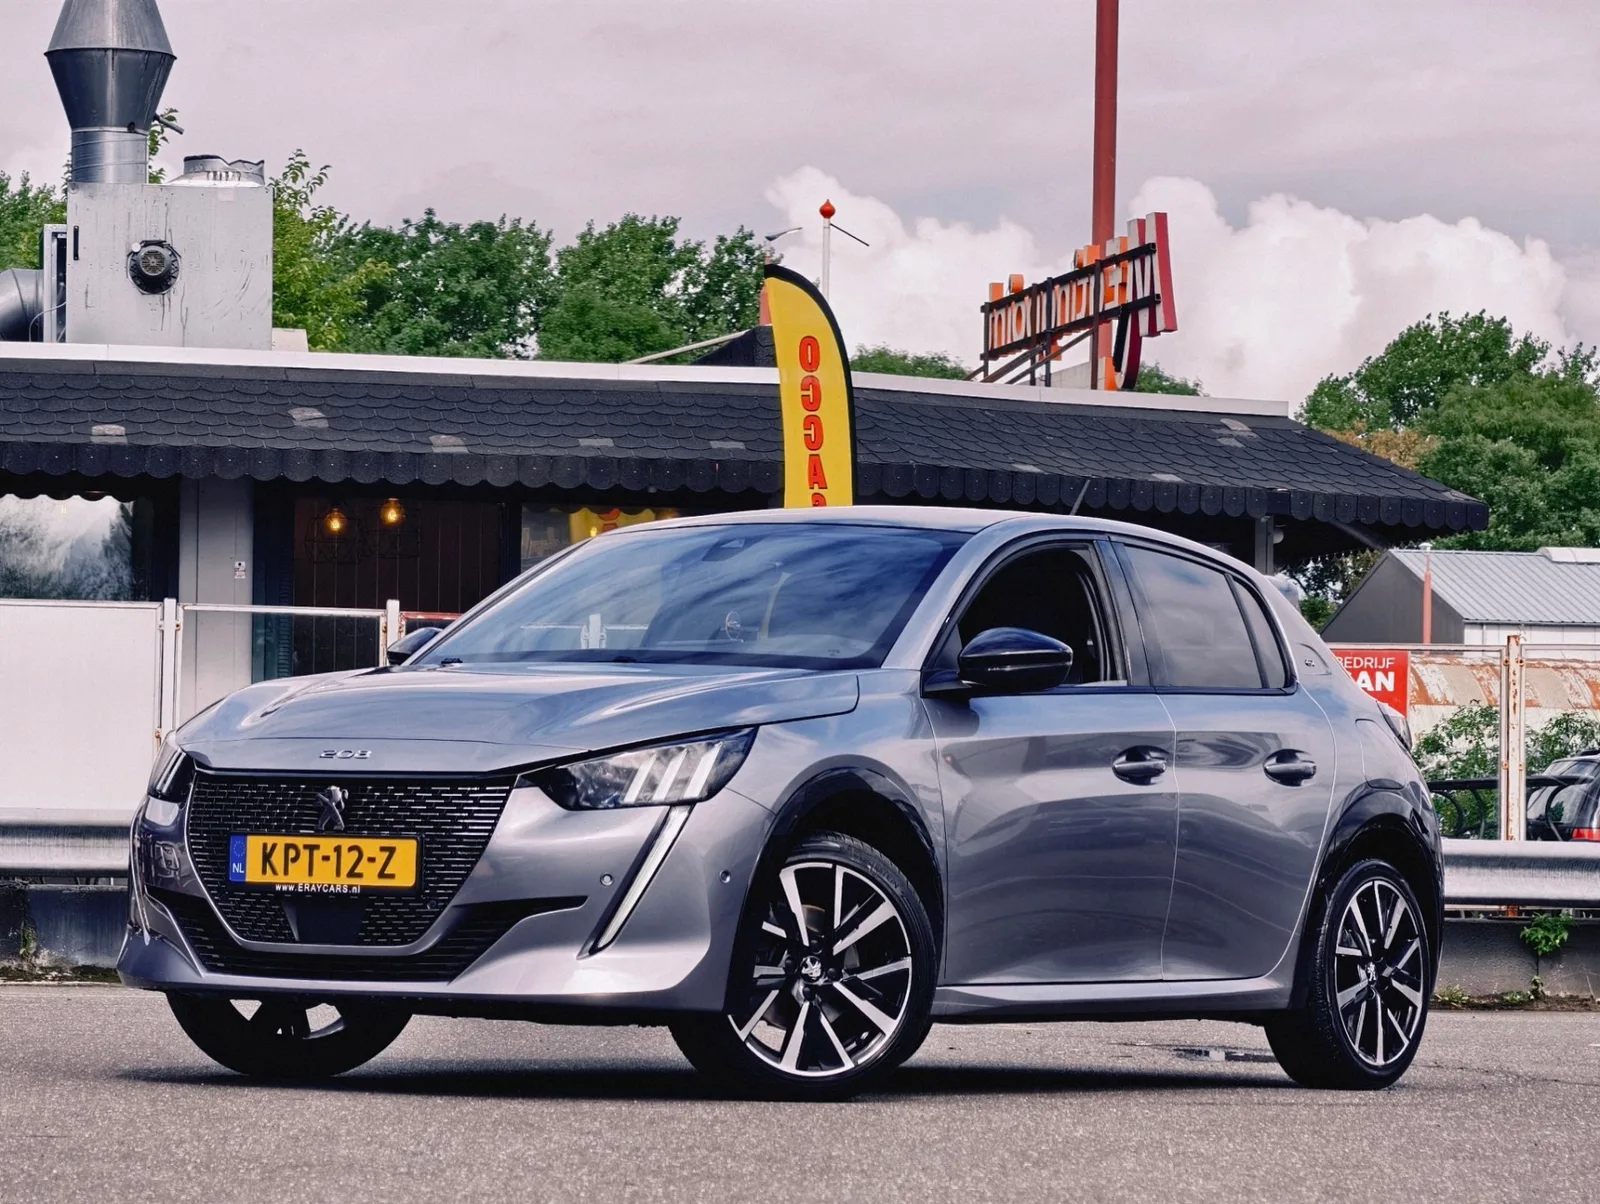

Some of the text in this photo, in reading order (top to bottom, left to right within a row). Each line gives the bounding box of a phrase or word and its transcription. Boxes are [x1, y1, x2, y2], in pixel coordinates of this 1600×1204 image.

[320, 749, 372, 760] 208
[261, 842, 397, 880] KPT-12-Z
[232, 863, 245, 874] NL
[275, 883, 361, 894] www.ERAYCARS.nl
